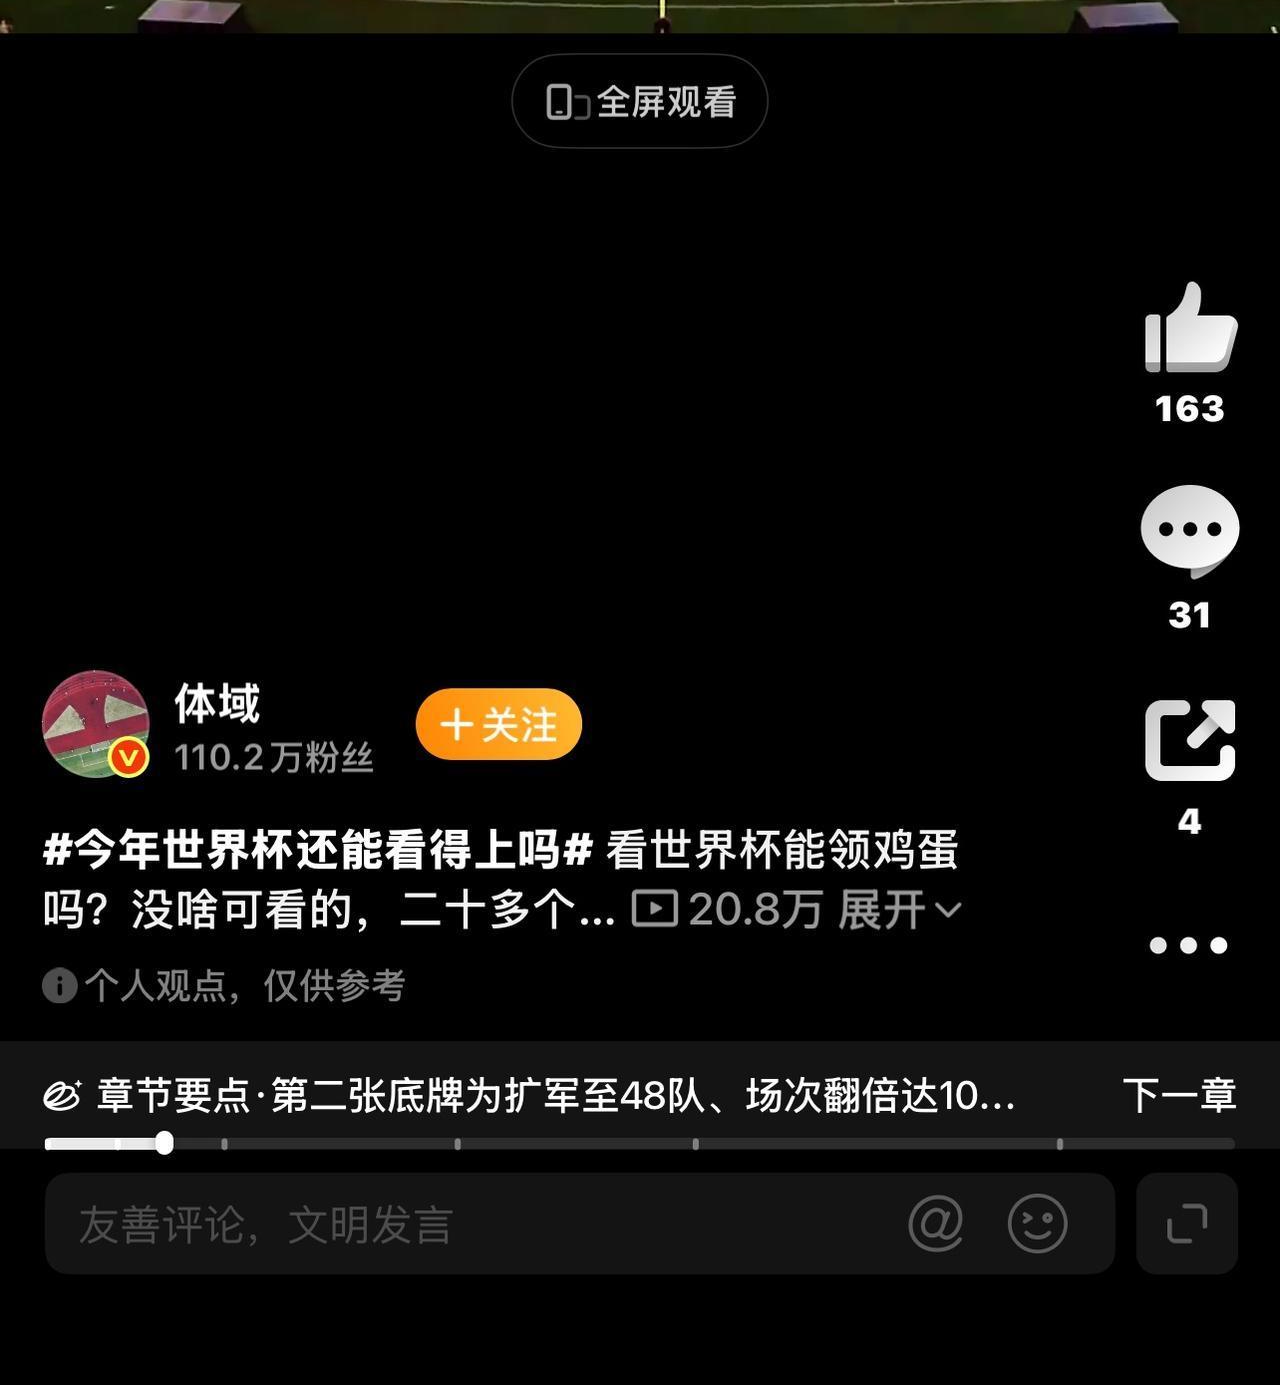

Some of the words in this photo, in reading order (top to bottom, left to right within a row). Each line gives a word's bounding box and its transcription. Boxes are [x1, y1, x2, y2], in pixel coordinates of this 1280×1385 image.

[597, 85, 736, 118] 全屏观看
[1156, 395, 1224, 422] 163
[1169, 601, 1208, 628] 31
[175, 682, 260, 724] 体域
[175, 741, 373, 773] 110.2万粉丝
[1178, 808, 1201, 834] 4
[43, 828, 593, 870] #今年世界杯还能看得上吗#
[607, 829, 958, 870] 看世界杯能领鸡蛋
[690, 890, 823, 929] 20.8万
[839, 889, 925, 930] 展开
[85, 968, 405, 1004] 个人观点，仅供参考
[1123, 1077, 1236, 1113] 下一章
[80, 1205, 453, 1246] 友善评论，文明发言
